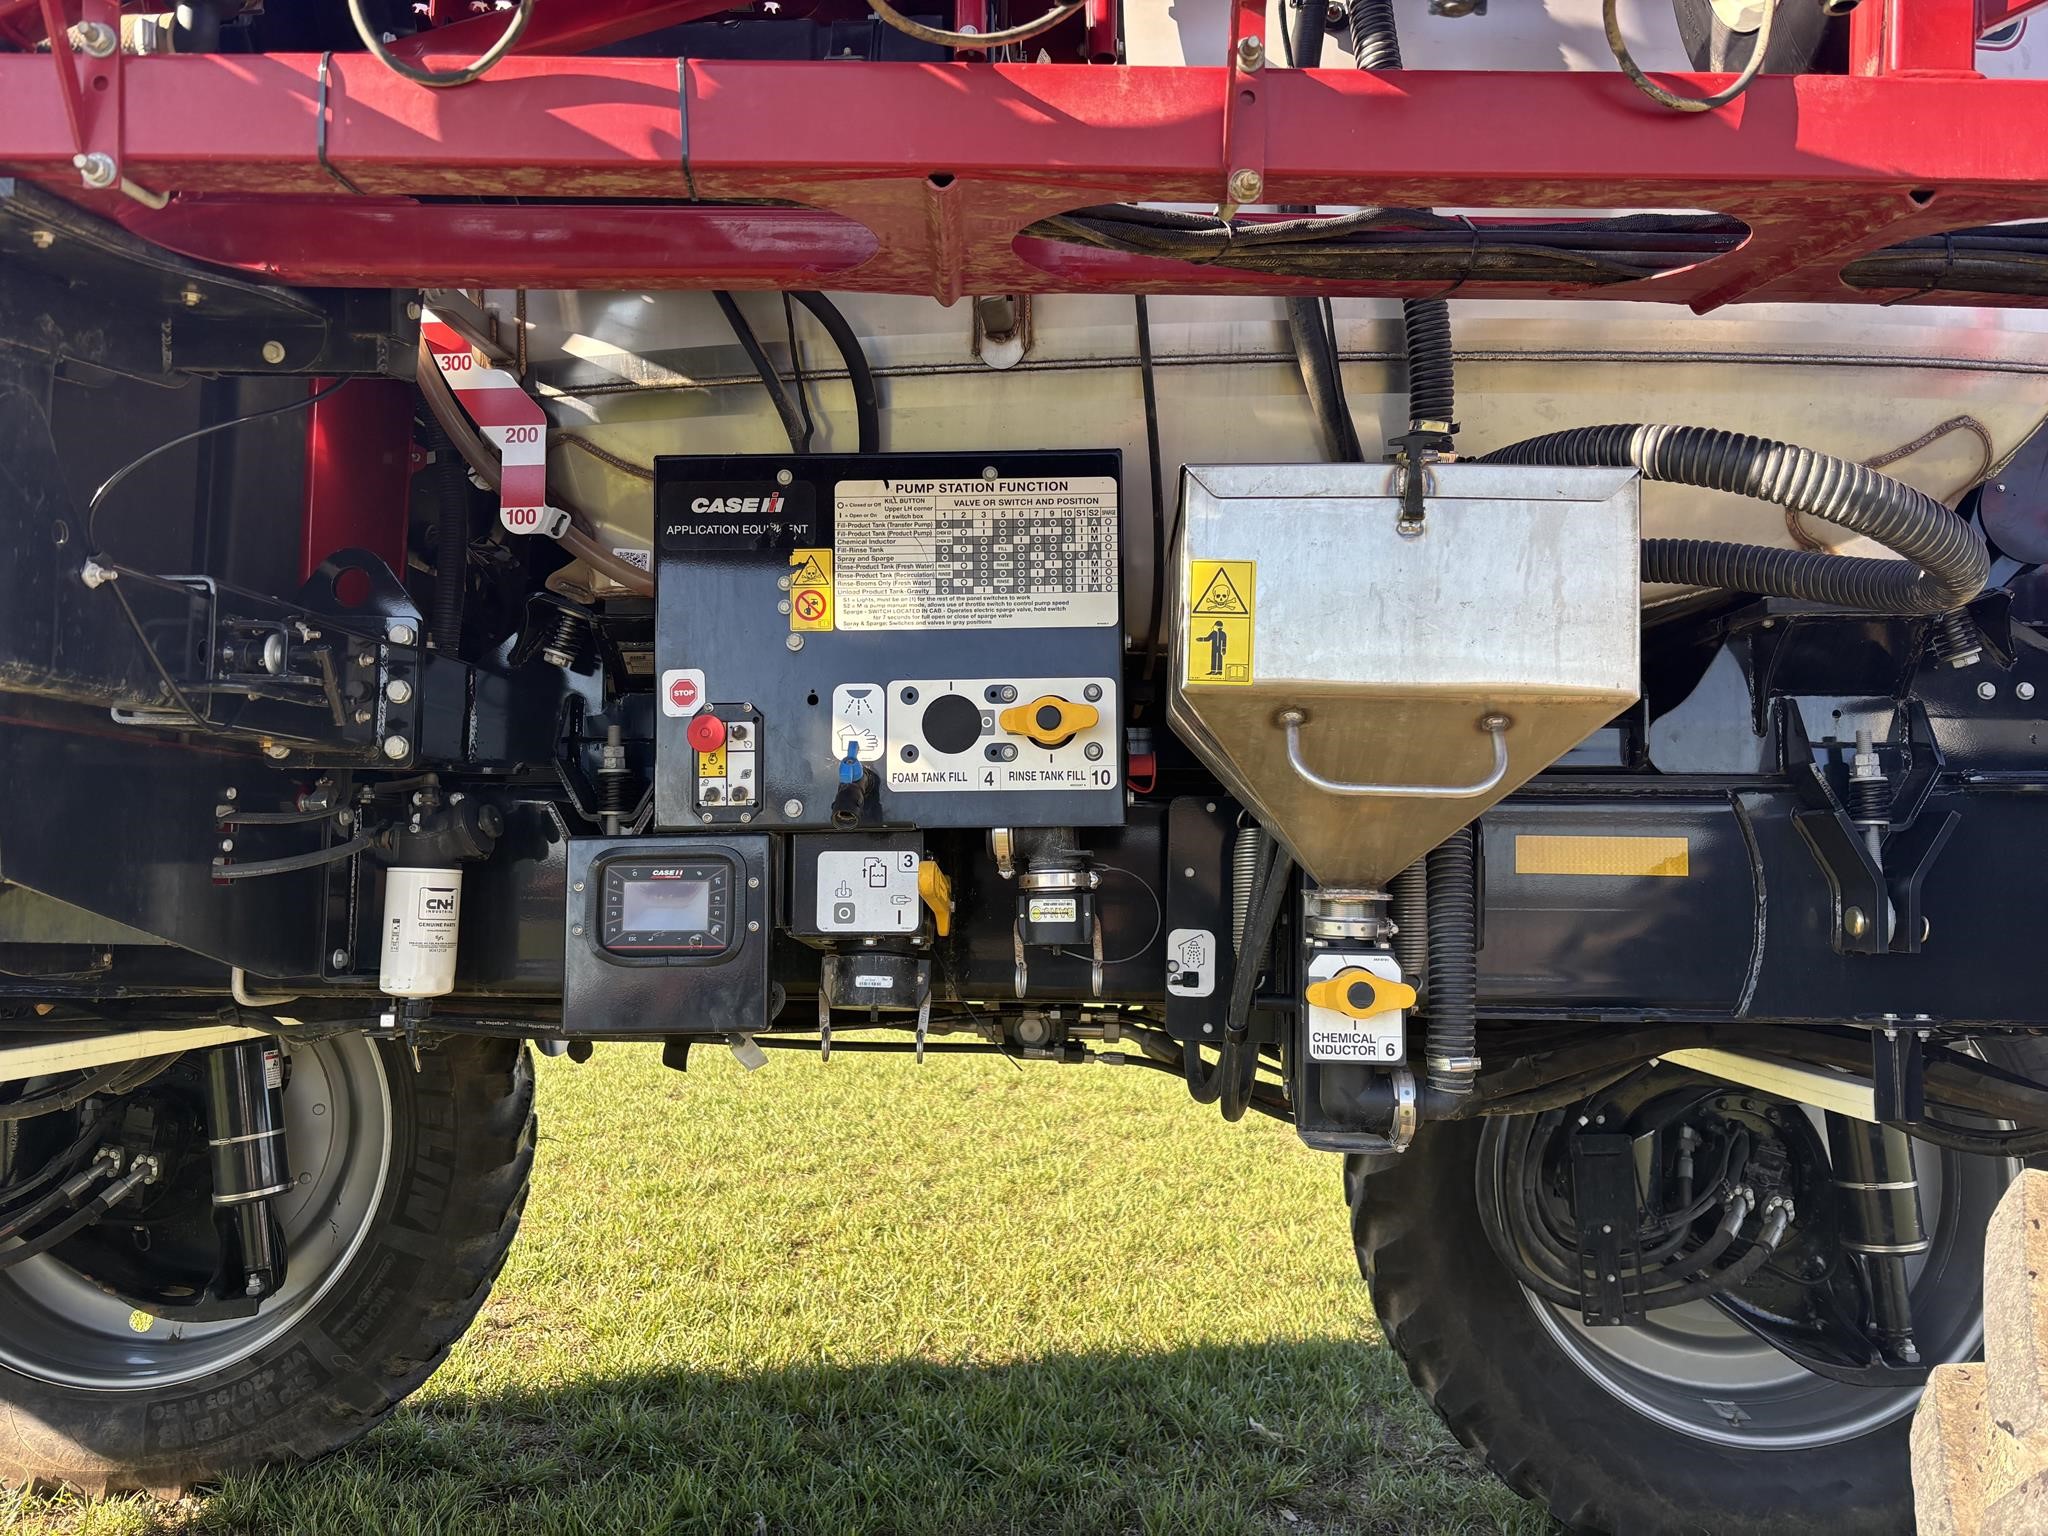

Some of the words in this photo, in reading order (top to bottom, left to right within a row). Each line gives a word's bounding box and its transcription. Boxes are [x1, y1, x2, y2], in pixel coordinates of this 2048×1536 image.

[442, 355, 471, 371] 300
[505, 427, 538, 443] 200
[896, 484, 935, 493] PUMP
[939, 482, 995, 493] STATION
[999, 482, 1068, 492] FUNCTION
[691, 498, 760, 513] CASE
[506, 509, 536, 524] 100
[666, 525, 740, 534] APPLICATION
[674, 689, 694, 697] STOP
[892, 772, 920, 783] FOAM
[922, 772, 947, 782] TANK
[949, 771, 968, 782] FILL
[984, 771, 994, 786] 4
[1008, 771, 1037, 781] RINSE
[1039, 771, 1064, 781] TANK
[1067, 770, 1086, 781] FILL
[1092, 770, 1110, 785] 10
[904, 855, 913, 867] 3
[1312, 1033, 1376, 1044] CHEMICAL
[1313, 1045, 1376, 1056] INDUCTOR
[1385, 1043, 1395, 1056] 6
